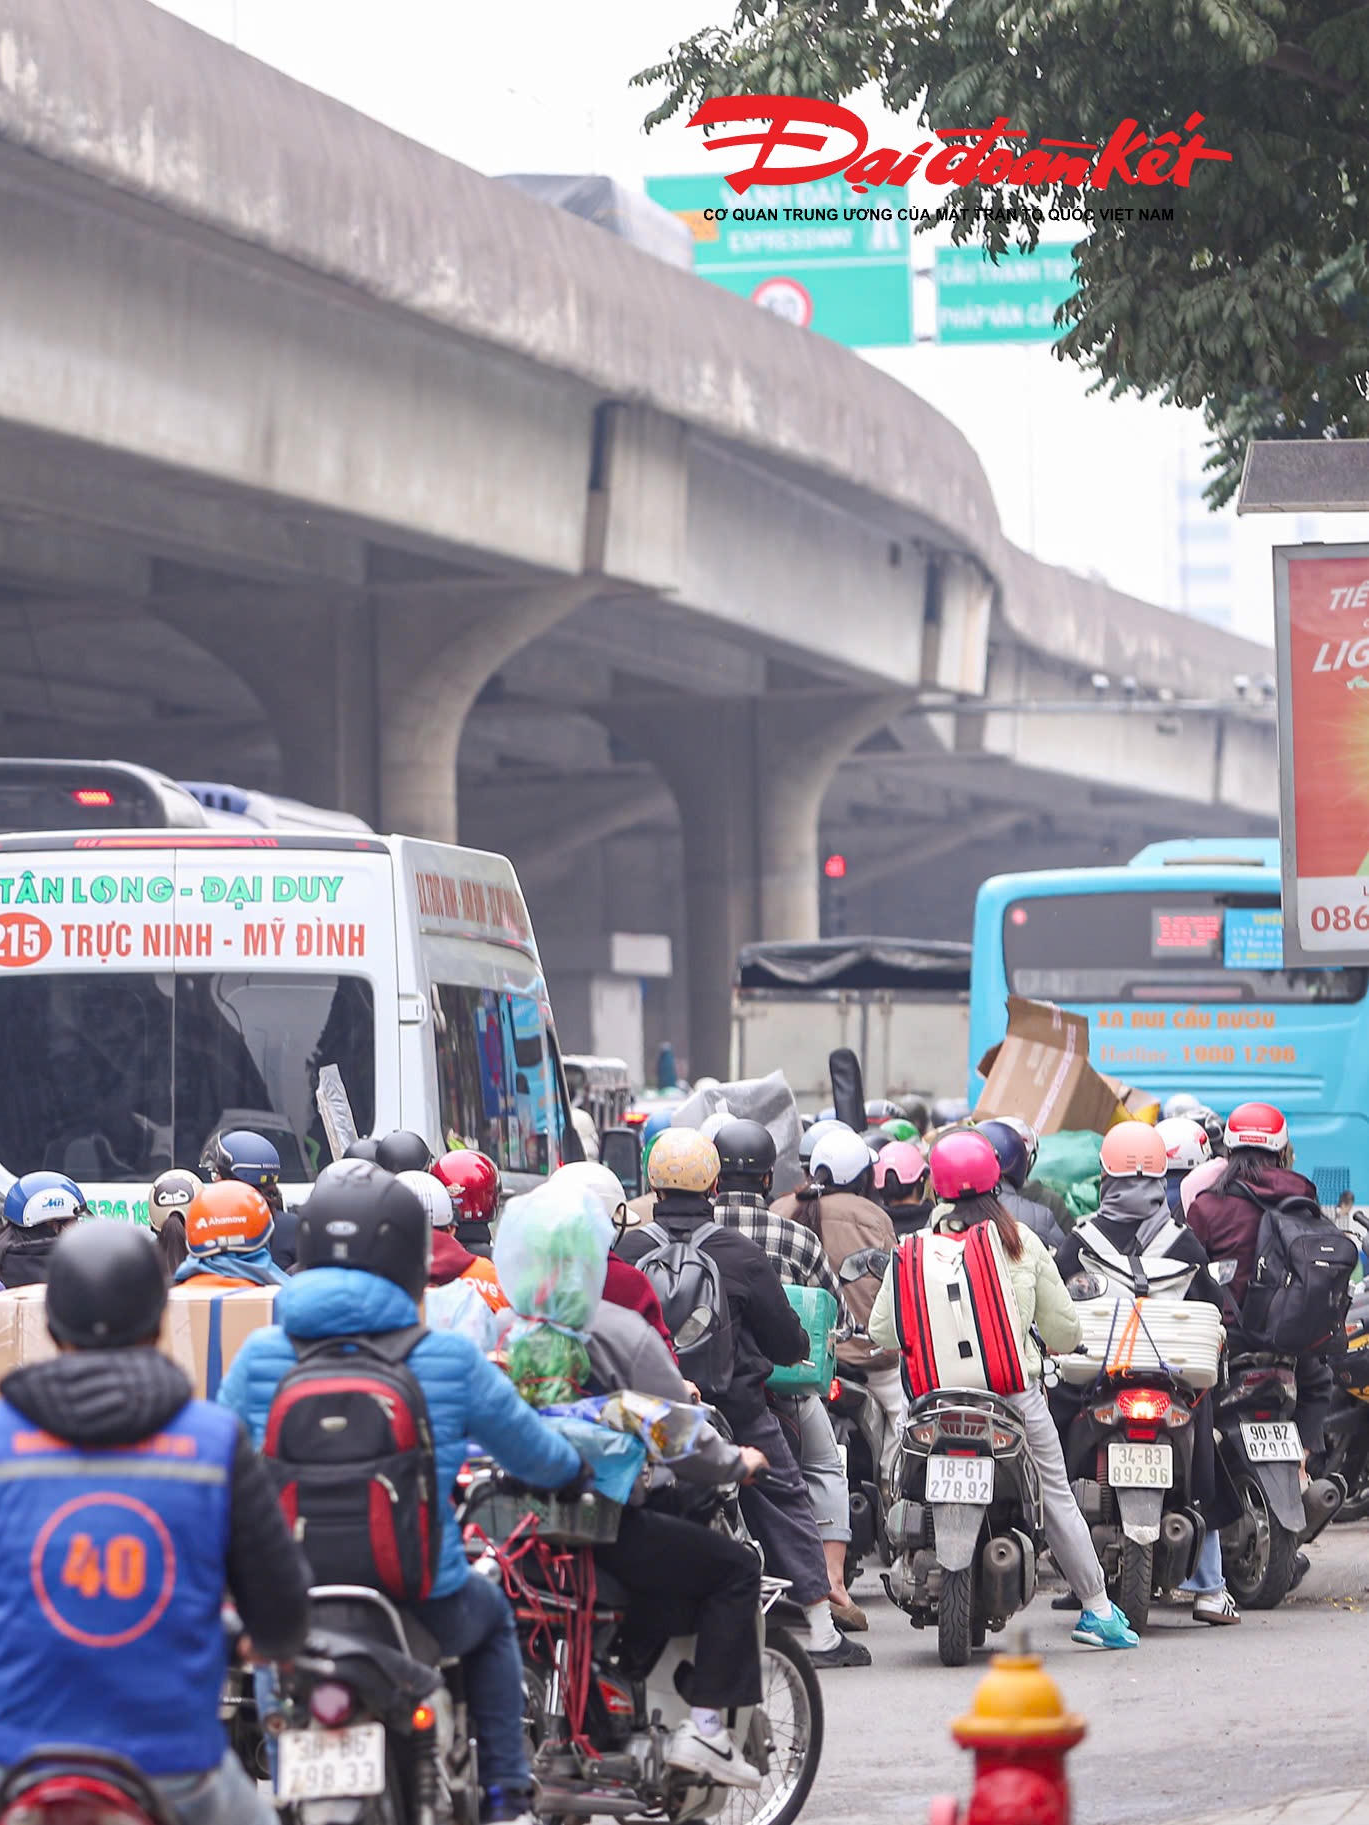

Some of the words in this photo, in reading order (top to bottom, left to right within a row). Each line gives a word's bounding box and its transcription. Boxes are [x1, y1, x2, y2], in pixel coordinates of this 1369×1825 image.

[72, 875, 175, 904] LONG
[201, 875, 263, 910] ĐẠI
[272, 875, 344, 903] DUY
[61, 920, 132, 964] TRỰC
[143, 923, 213, 957] NINH
[243, 916, 286, 957] MỸ
[296, 916, 366, 957] ĐÌNH
[1118, 1447, 1162, 1465] 34-B3
[939, 1459, 983, 1480] 18-G1
[1113, 1466, 1168, 1485] 892.96
[930, 1480, 989, 1500] 278.92
[60, 1532, 148, 1600] 40
